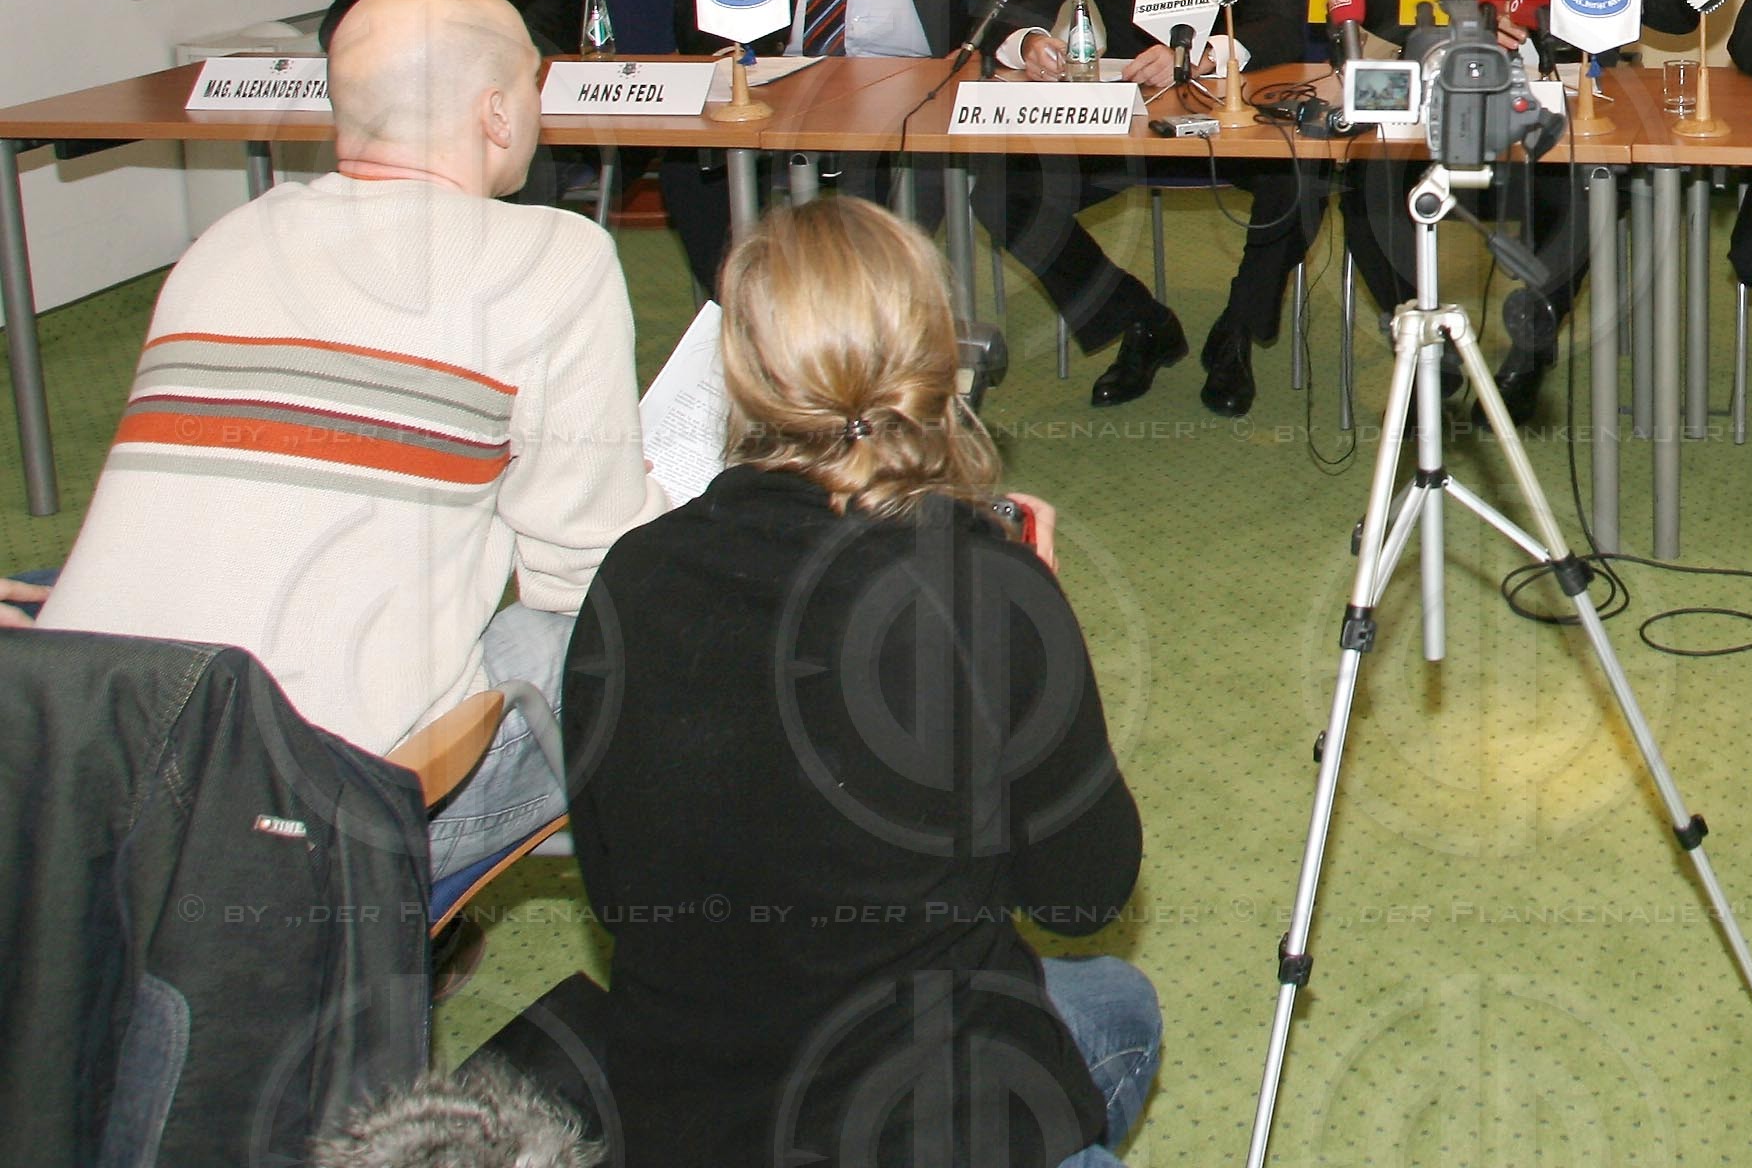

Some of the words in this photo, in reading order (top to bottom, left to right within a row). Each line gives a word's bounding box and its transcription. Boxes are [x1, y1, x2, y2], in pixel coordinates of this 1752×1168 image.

[204, 80, 231, 98] MAG.
[233, 80, 302, 98] ALEXANDER
[578, 84, 623, 101] HANS
[626, 84, 664, 102] FEDL
[958, 106, 986, 124] DR.
[993, 106, 1010, 124] N.
[1017, 106, 1128, 125] SCHERBAUM
